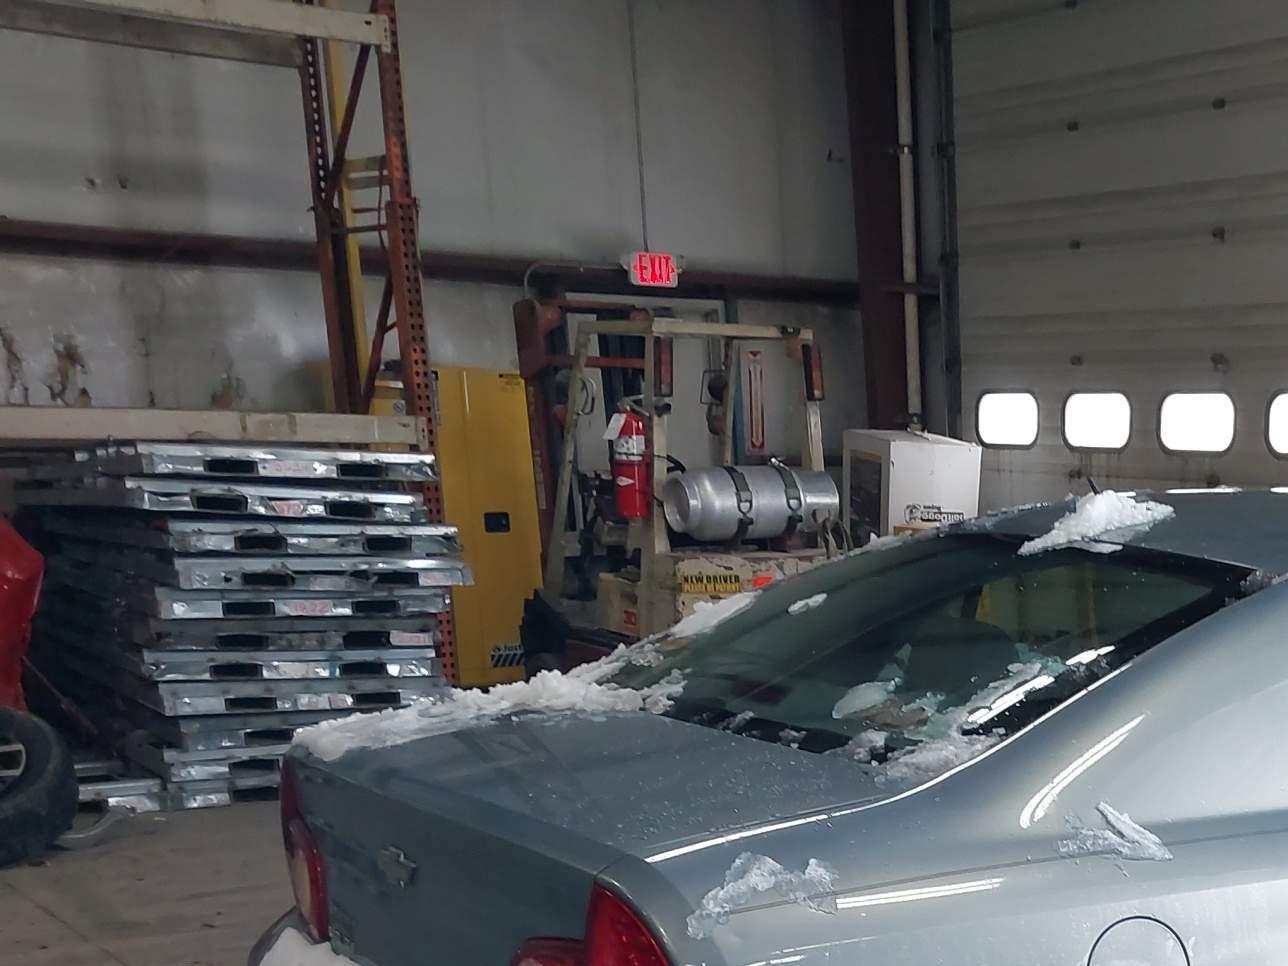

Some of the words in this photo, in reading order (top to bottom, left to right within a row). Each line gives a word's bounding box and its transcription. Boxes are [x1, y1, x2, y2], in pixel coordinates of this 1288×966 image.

[638, 254, 672, 284] EXIT
[683, 575, 704, 584] NEW
[706, 575, 740, 584] DRIVER
